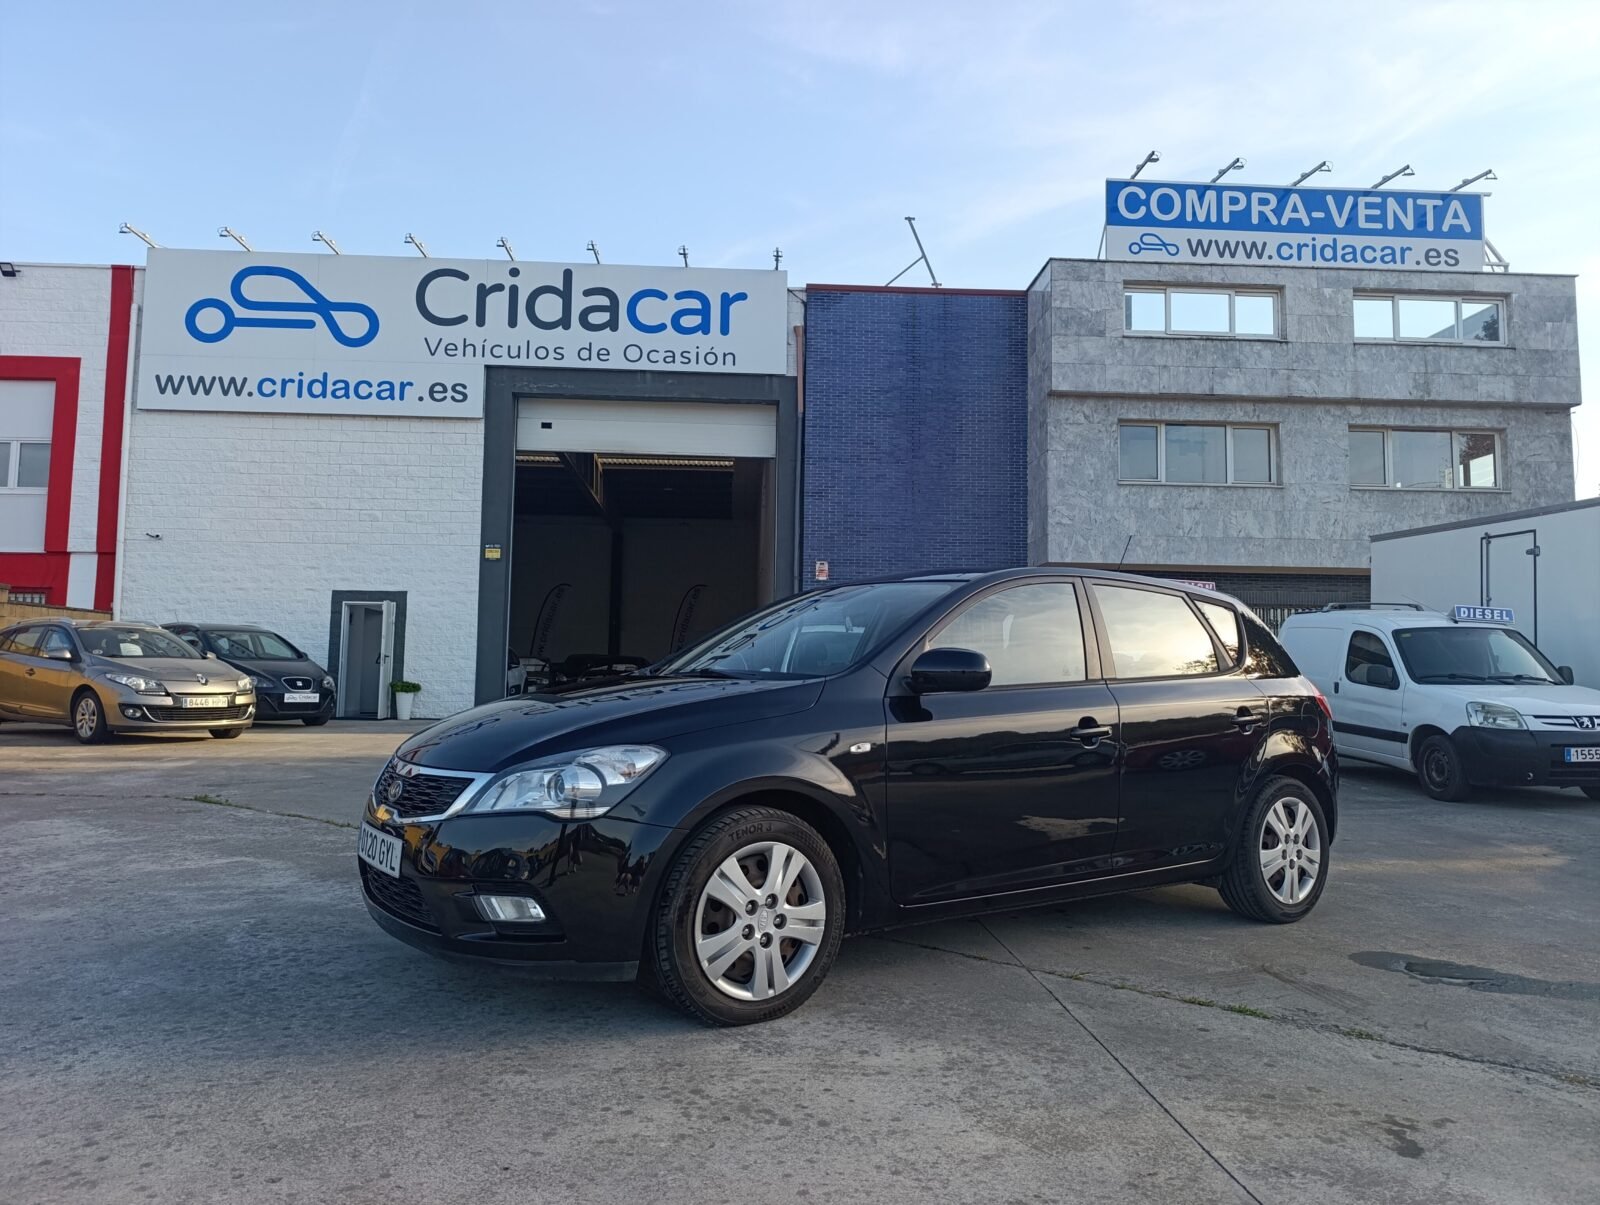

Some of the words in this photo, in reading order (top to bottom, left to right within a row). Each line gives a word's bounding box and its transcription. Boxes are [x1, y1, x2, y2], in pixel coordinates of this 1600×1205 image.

[1117, 186, 1472, 233] COMPRA-VENTA
[1186, 237, 1460, 267] www.cridacar.es
[416, 267, 748, 336] Cridacar
[424, 337, 565, 361] Vehículos
[577, 342, 610, 362] de
[623, 344, 736, 367] Ocasión
[155, 372, 469, 403] www.cridacar.es
[1460, 607, 1510, 620] DIESEL
[379, 838, 396, 872] GYL
